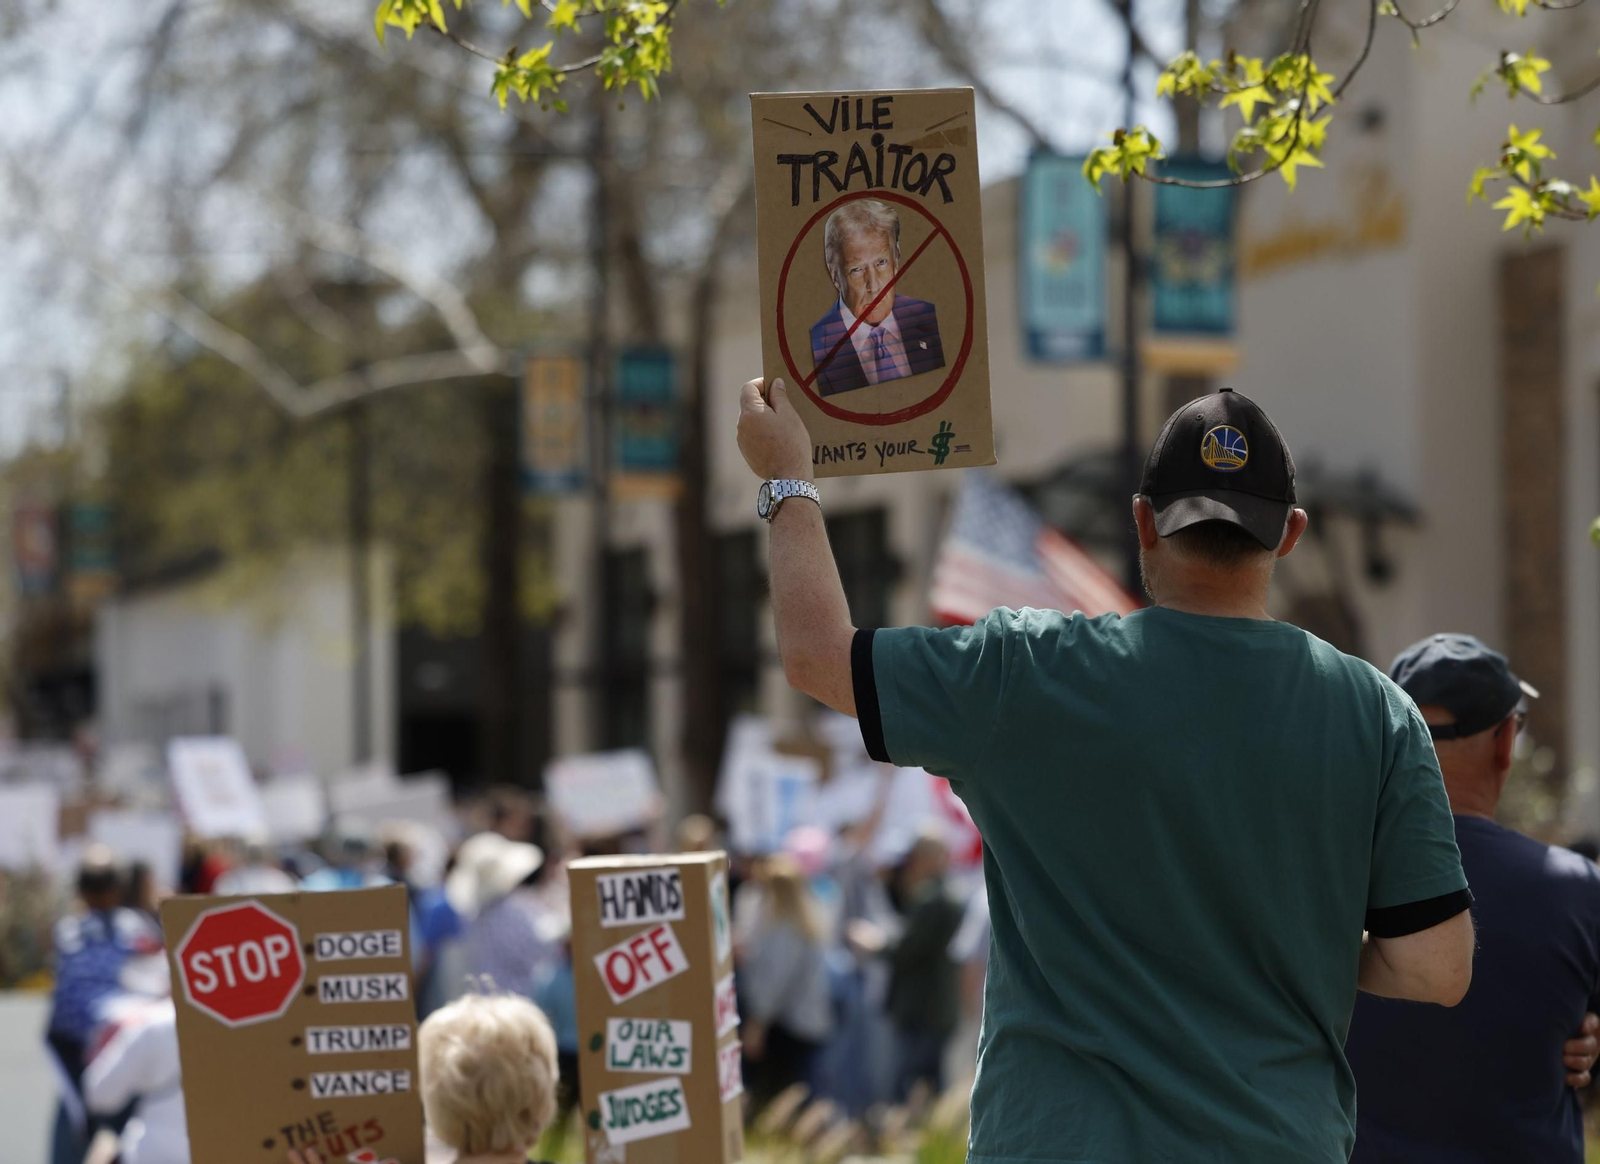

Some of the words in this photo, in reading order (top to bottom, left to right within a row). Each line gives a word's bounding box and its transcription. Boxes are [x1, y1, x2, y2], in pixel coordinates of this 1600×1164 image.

[874, 439, 925, 467] YOUR
[598, 873, 681, 920] HANDS
[316, 932, 400, 958] DOGE
[190, 934, 291, 994] STOP
[604, 925, 675, 997] OFF
[321, 977, 405, 1000] MUSK
[309, 1027, 409, 1051] TRUMP
[617, 1020, 676, 1043] OUR
[610, 1043, 689, 1068] LAWS
[311, 1071, 408, 1096] VANCE
[606, 1088, 683, 1130] JUDGES
[280, 1109, 338, 1147] THE
